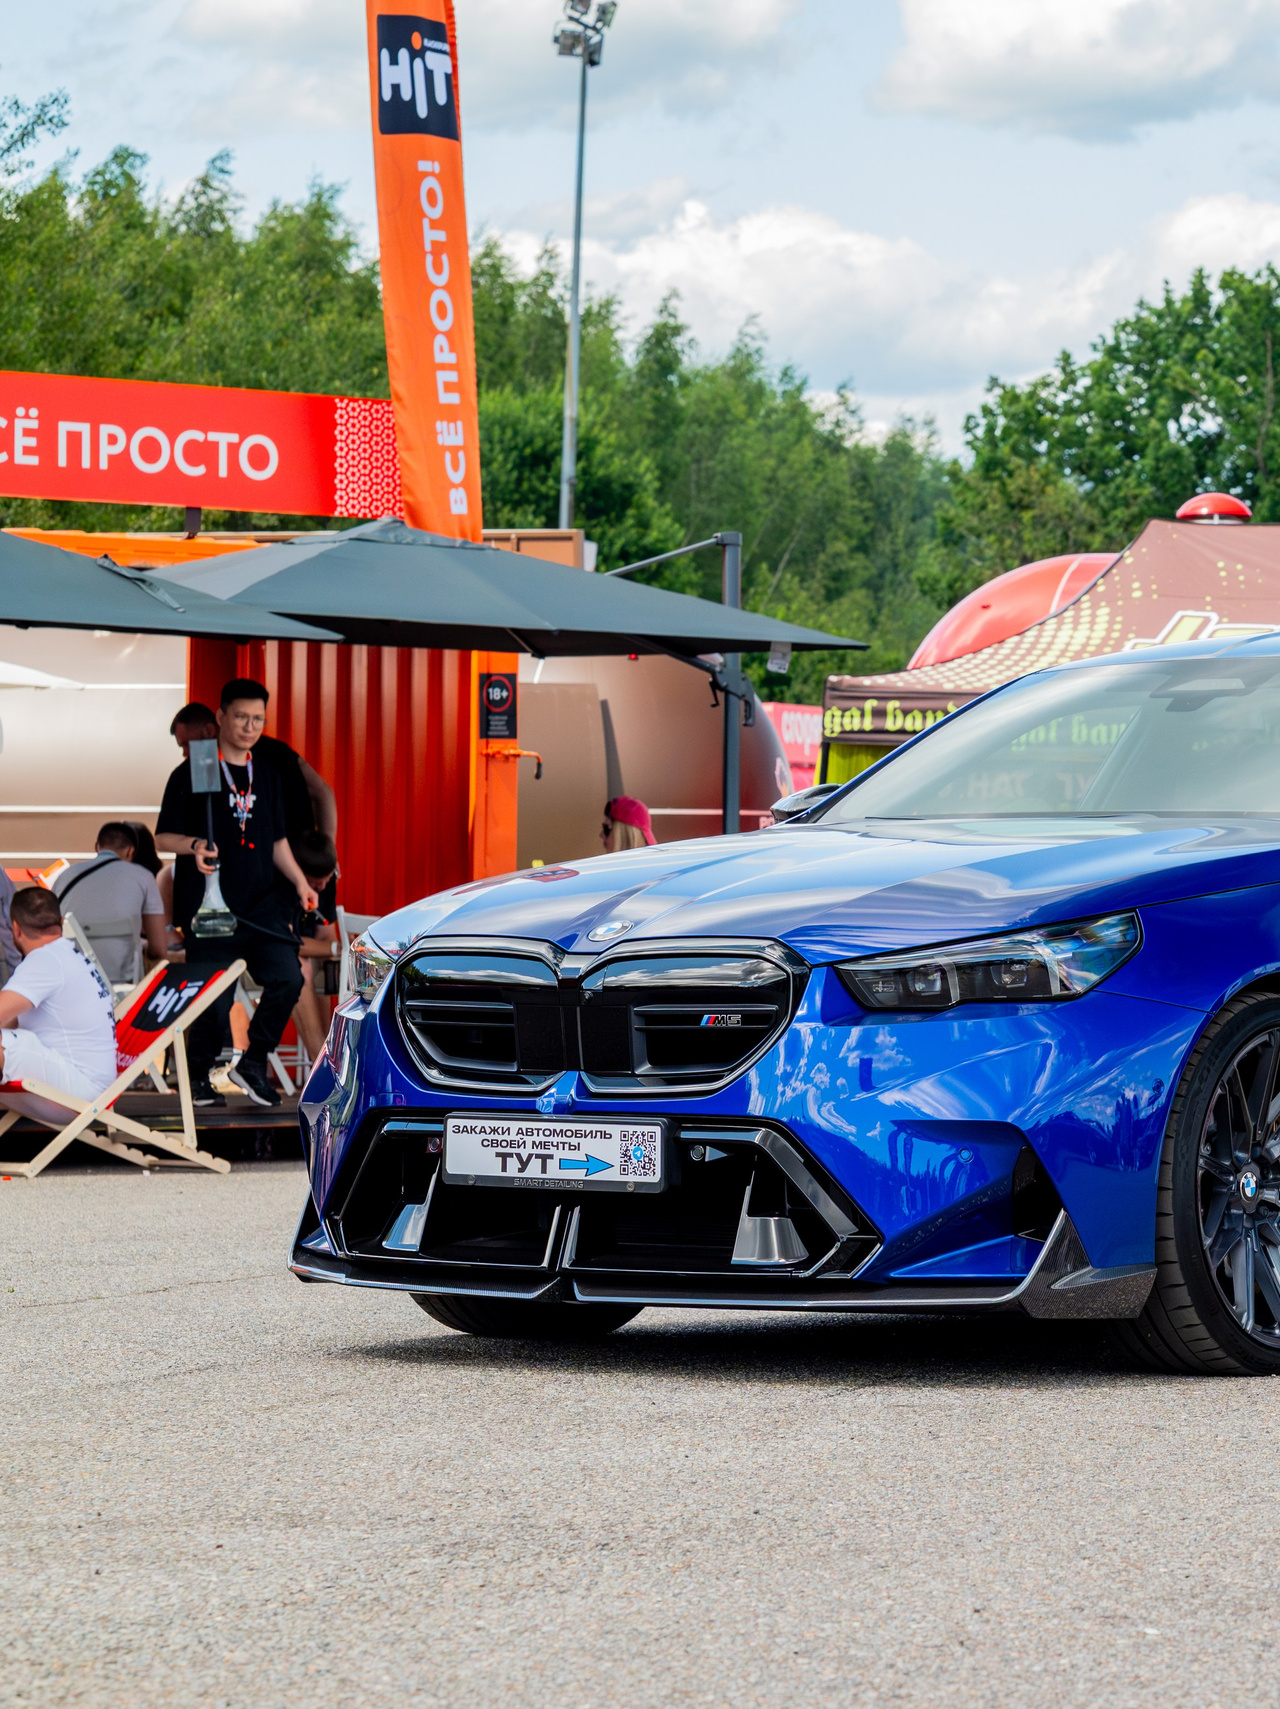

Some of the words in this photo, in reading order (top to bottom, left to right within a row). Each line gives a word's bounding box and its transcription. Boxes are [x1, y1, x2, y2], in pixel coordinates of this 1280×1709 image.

[417, 160, 461, 405] ПРОСТО!
[0, 407, 39, 466] Ё
[58, 421, 279, 481] ПРОСТО
[436, 420, 468, 515] ВСЁ
[487, 687, 509, 701] 18+
[885, 700, 957, 733] ban
[703, 1014, 742, 1027] M5
[452, 1124, 511, 1136] ЗАКАЖИ
[516, 1127, 613, 1140] АВТОМОБИЛЬ
[481, 1137, 527, 1149] СВОЕЙ
[531, 1141, 581, 1152] МЕЧТЫ
[495, 1152, 554, 1175] ТУТ
[514, 1178, 544, 1187] SMART
[544, 1179, 584, 1189] DETAILING
